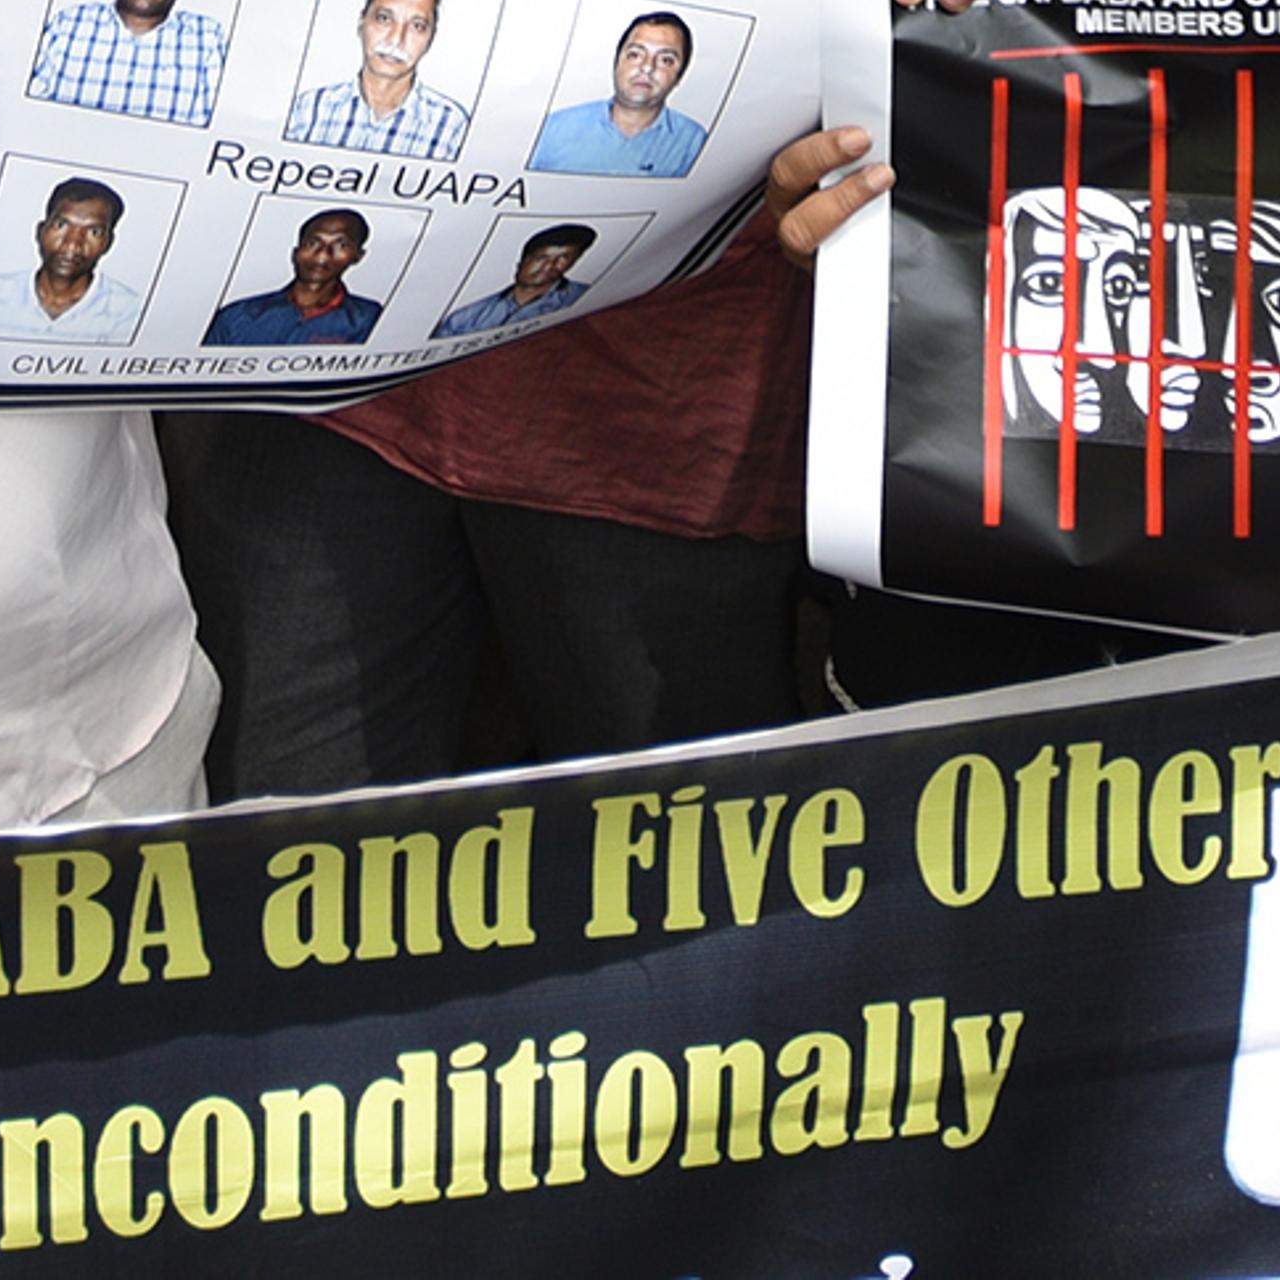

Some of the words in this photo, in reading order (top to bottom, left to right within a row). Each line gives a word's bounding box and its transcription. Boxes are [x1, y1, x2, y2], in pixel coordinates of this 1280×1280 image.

[1075, 8, 1245, 37] MEMBERS
[206, 139, 379, 196] Repeal
[392, 164, 527, 208] UAPA
[11, 354, 90, 375] CIVIL
[100, 356, 260, 376] LIBERTIES
[266, 346, 444, 375] COMMITTEE
[263, 809, 534, 971] and
[586, 784, 868, 941] Five
